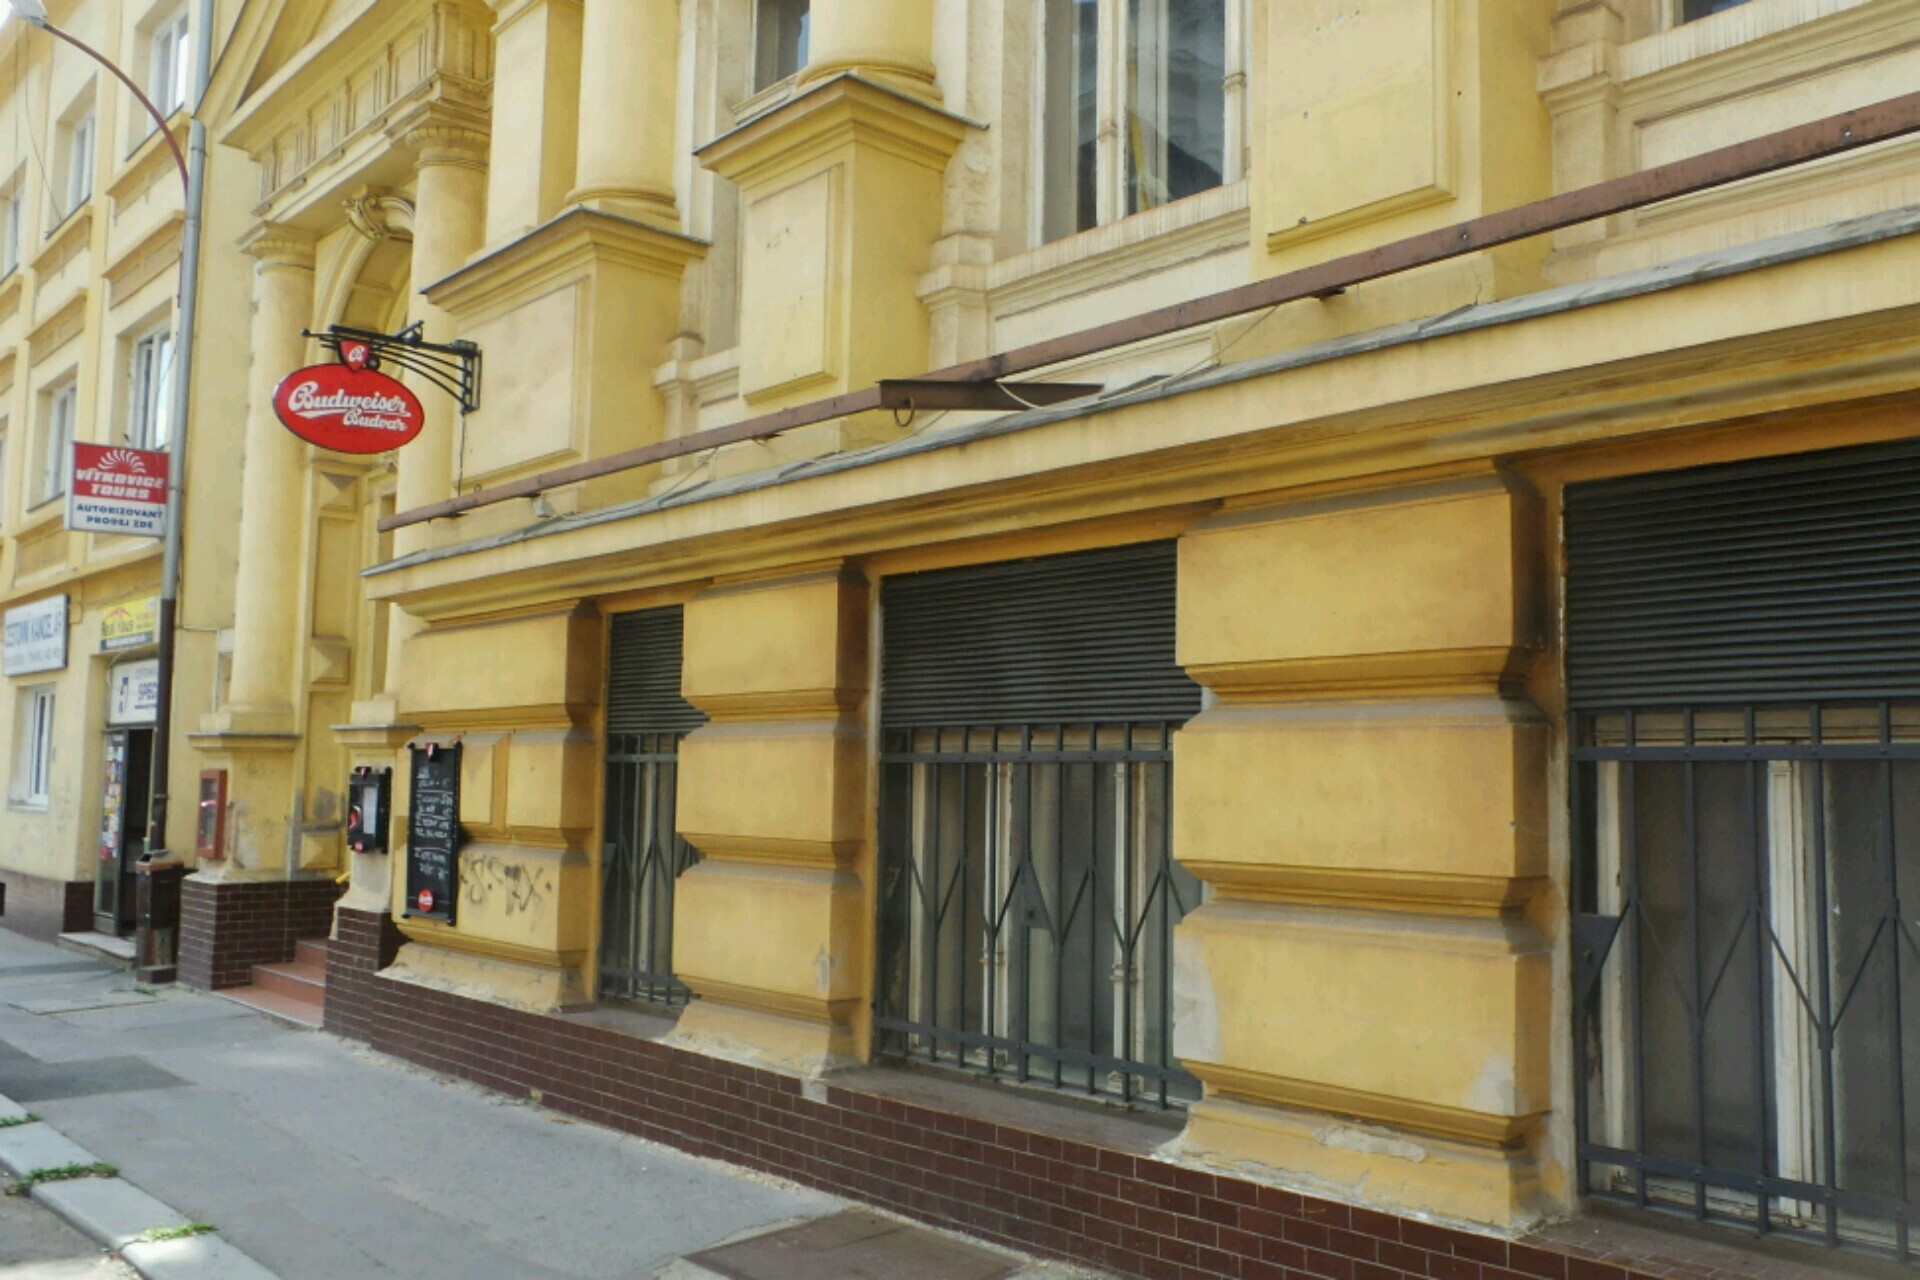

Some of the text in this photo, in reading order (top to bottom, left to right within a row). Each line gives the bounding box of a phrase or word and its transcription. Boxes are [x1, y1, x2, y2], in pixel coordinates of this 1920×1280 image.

[288, 381, 407, 414] Budweiser
[343, 409, 407, 431] Budvar
[91, 483, 150, 499] TOURS
